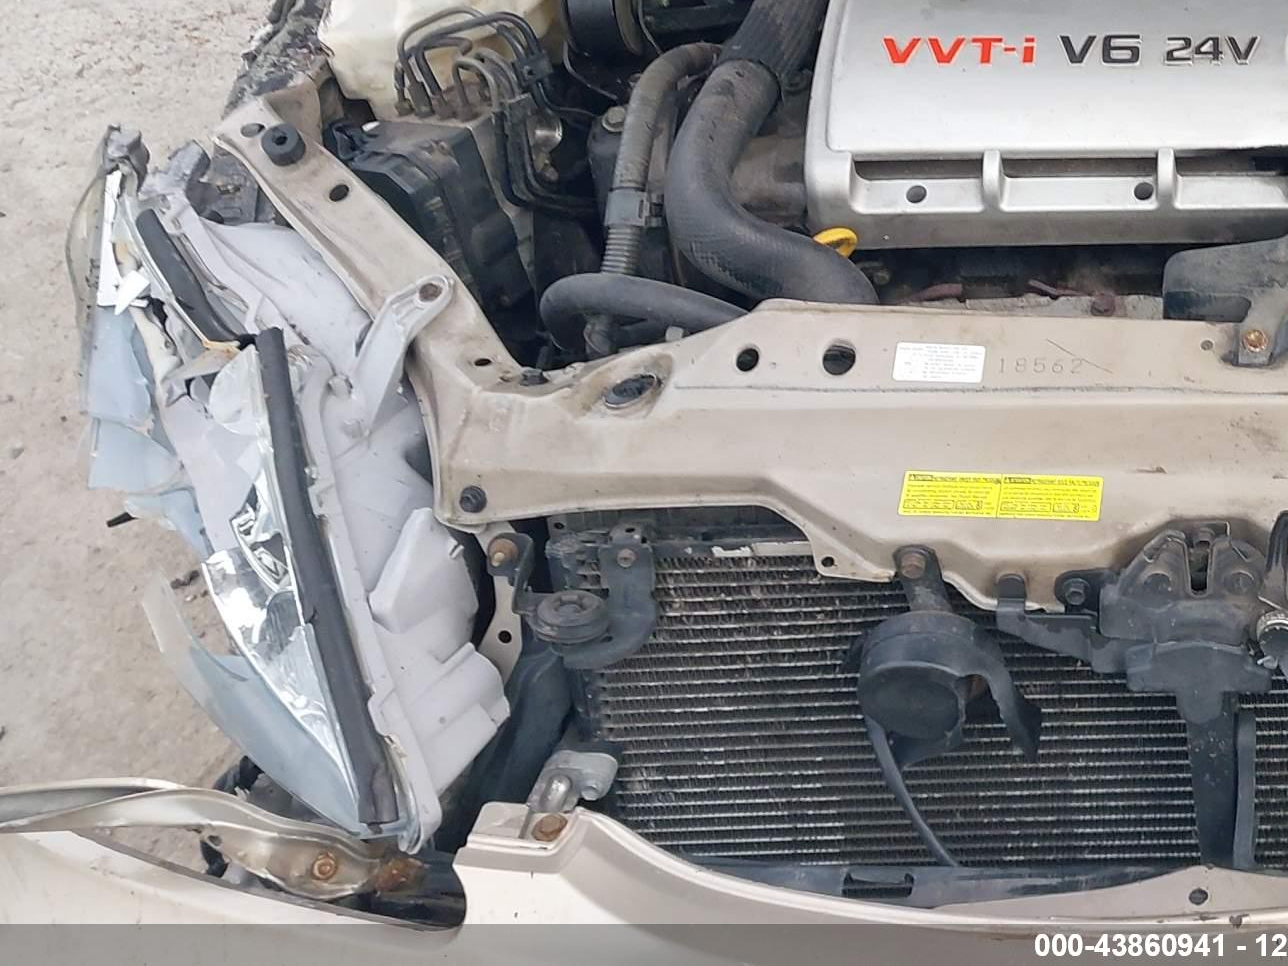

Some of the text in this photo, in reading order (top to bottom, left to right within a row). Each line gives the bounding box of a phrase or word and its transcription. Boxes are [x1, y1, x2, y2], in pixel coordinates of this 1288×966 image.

[881, 34, 1260, 66] VVT-i V6 24V
[999, 356, 1084, 375] 18562
